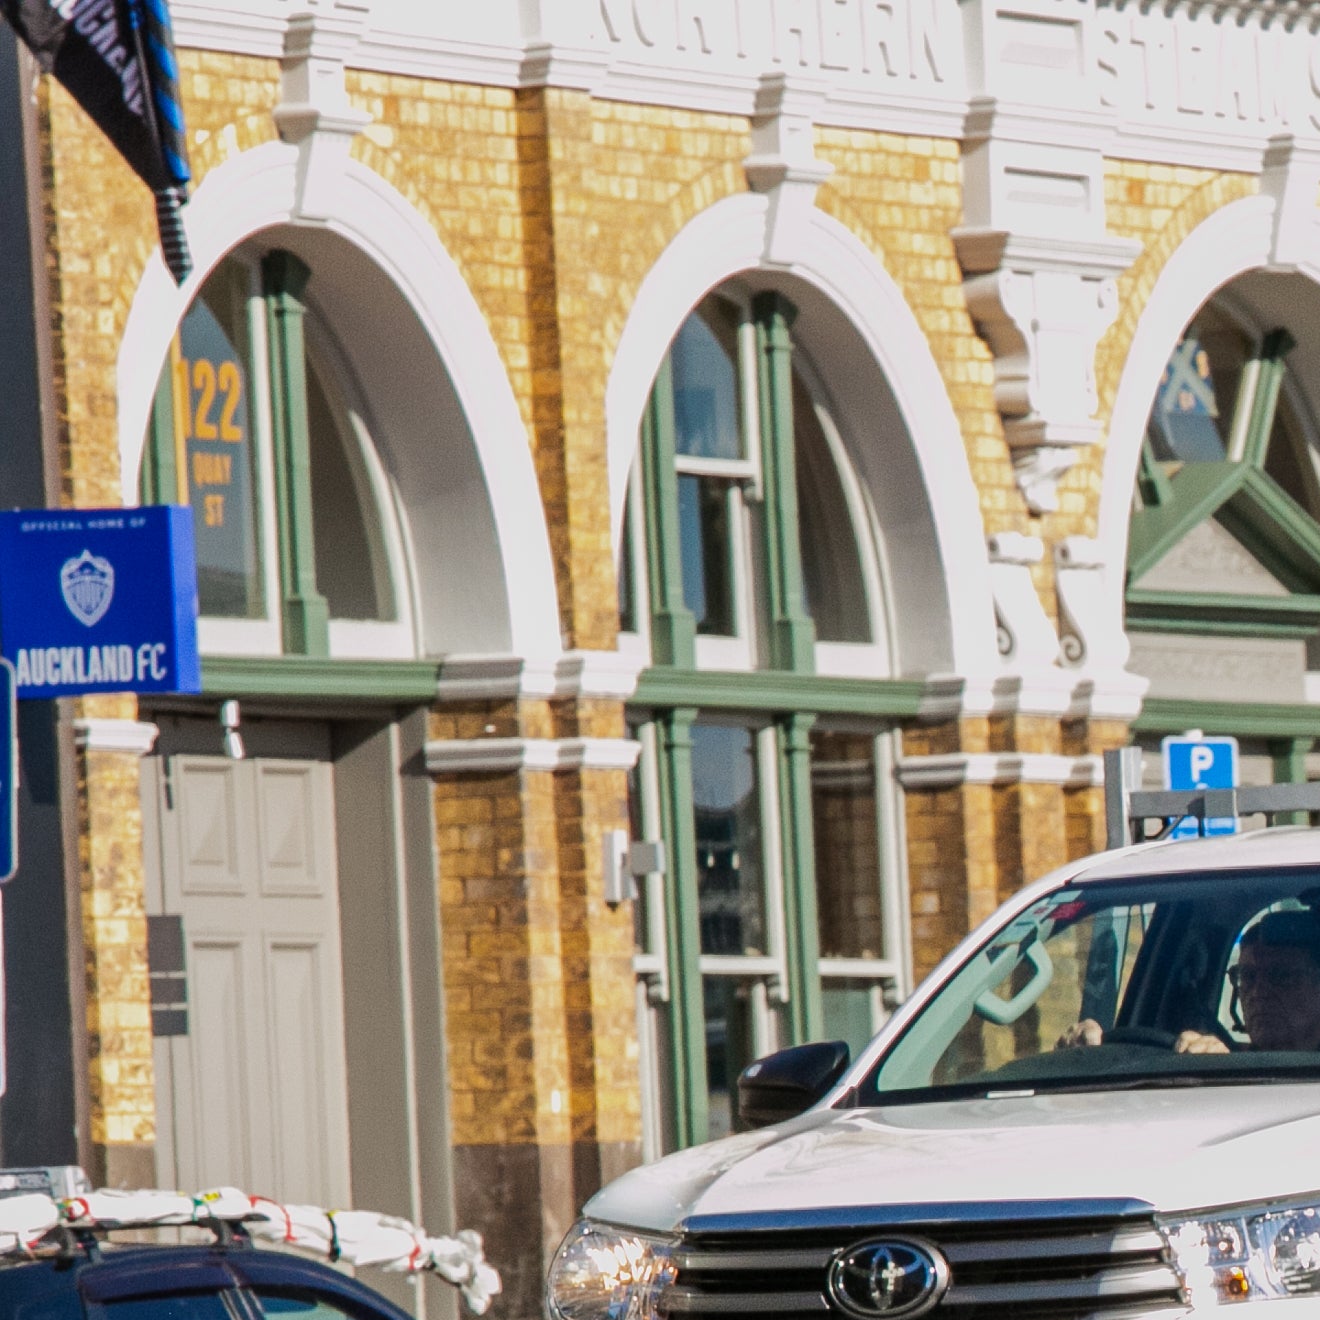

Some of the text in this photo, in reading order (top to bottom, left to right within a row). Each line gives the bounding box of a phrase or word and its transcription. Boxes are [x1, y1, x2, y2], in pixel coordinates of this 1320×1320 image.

[177, 359, 243, 442] 122
[22, 517, 146, 532] OFFICIAL HOME OF
[204, 494, 225, 527] ST
[17, 642, 168, 686] AUCKLAND FC
[1190, 746, 1214, 783] P
